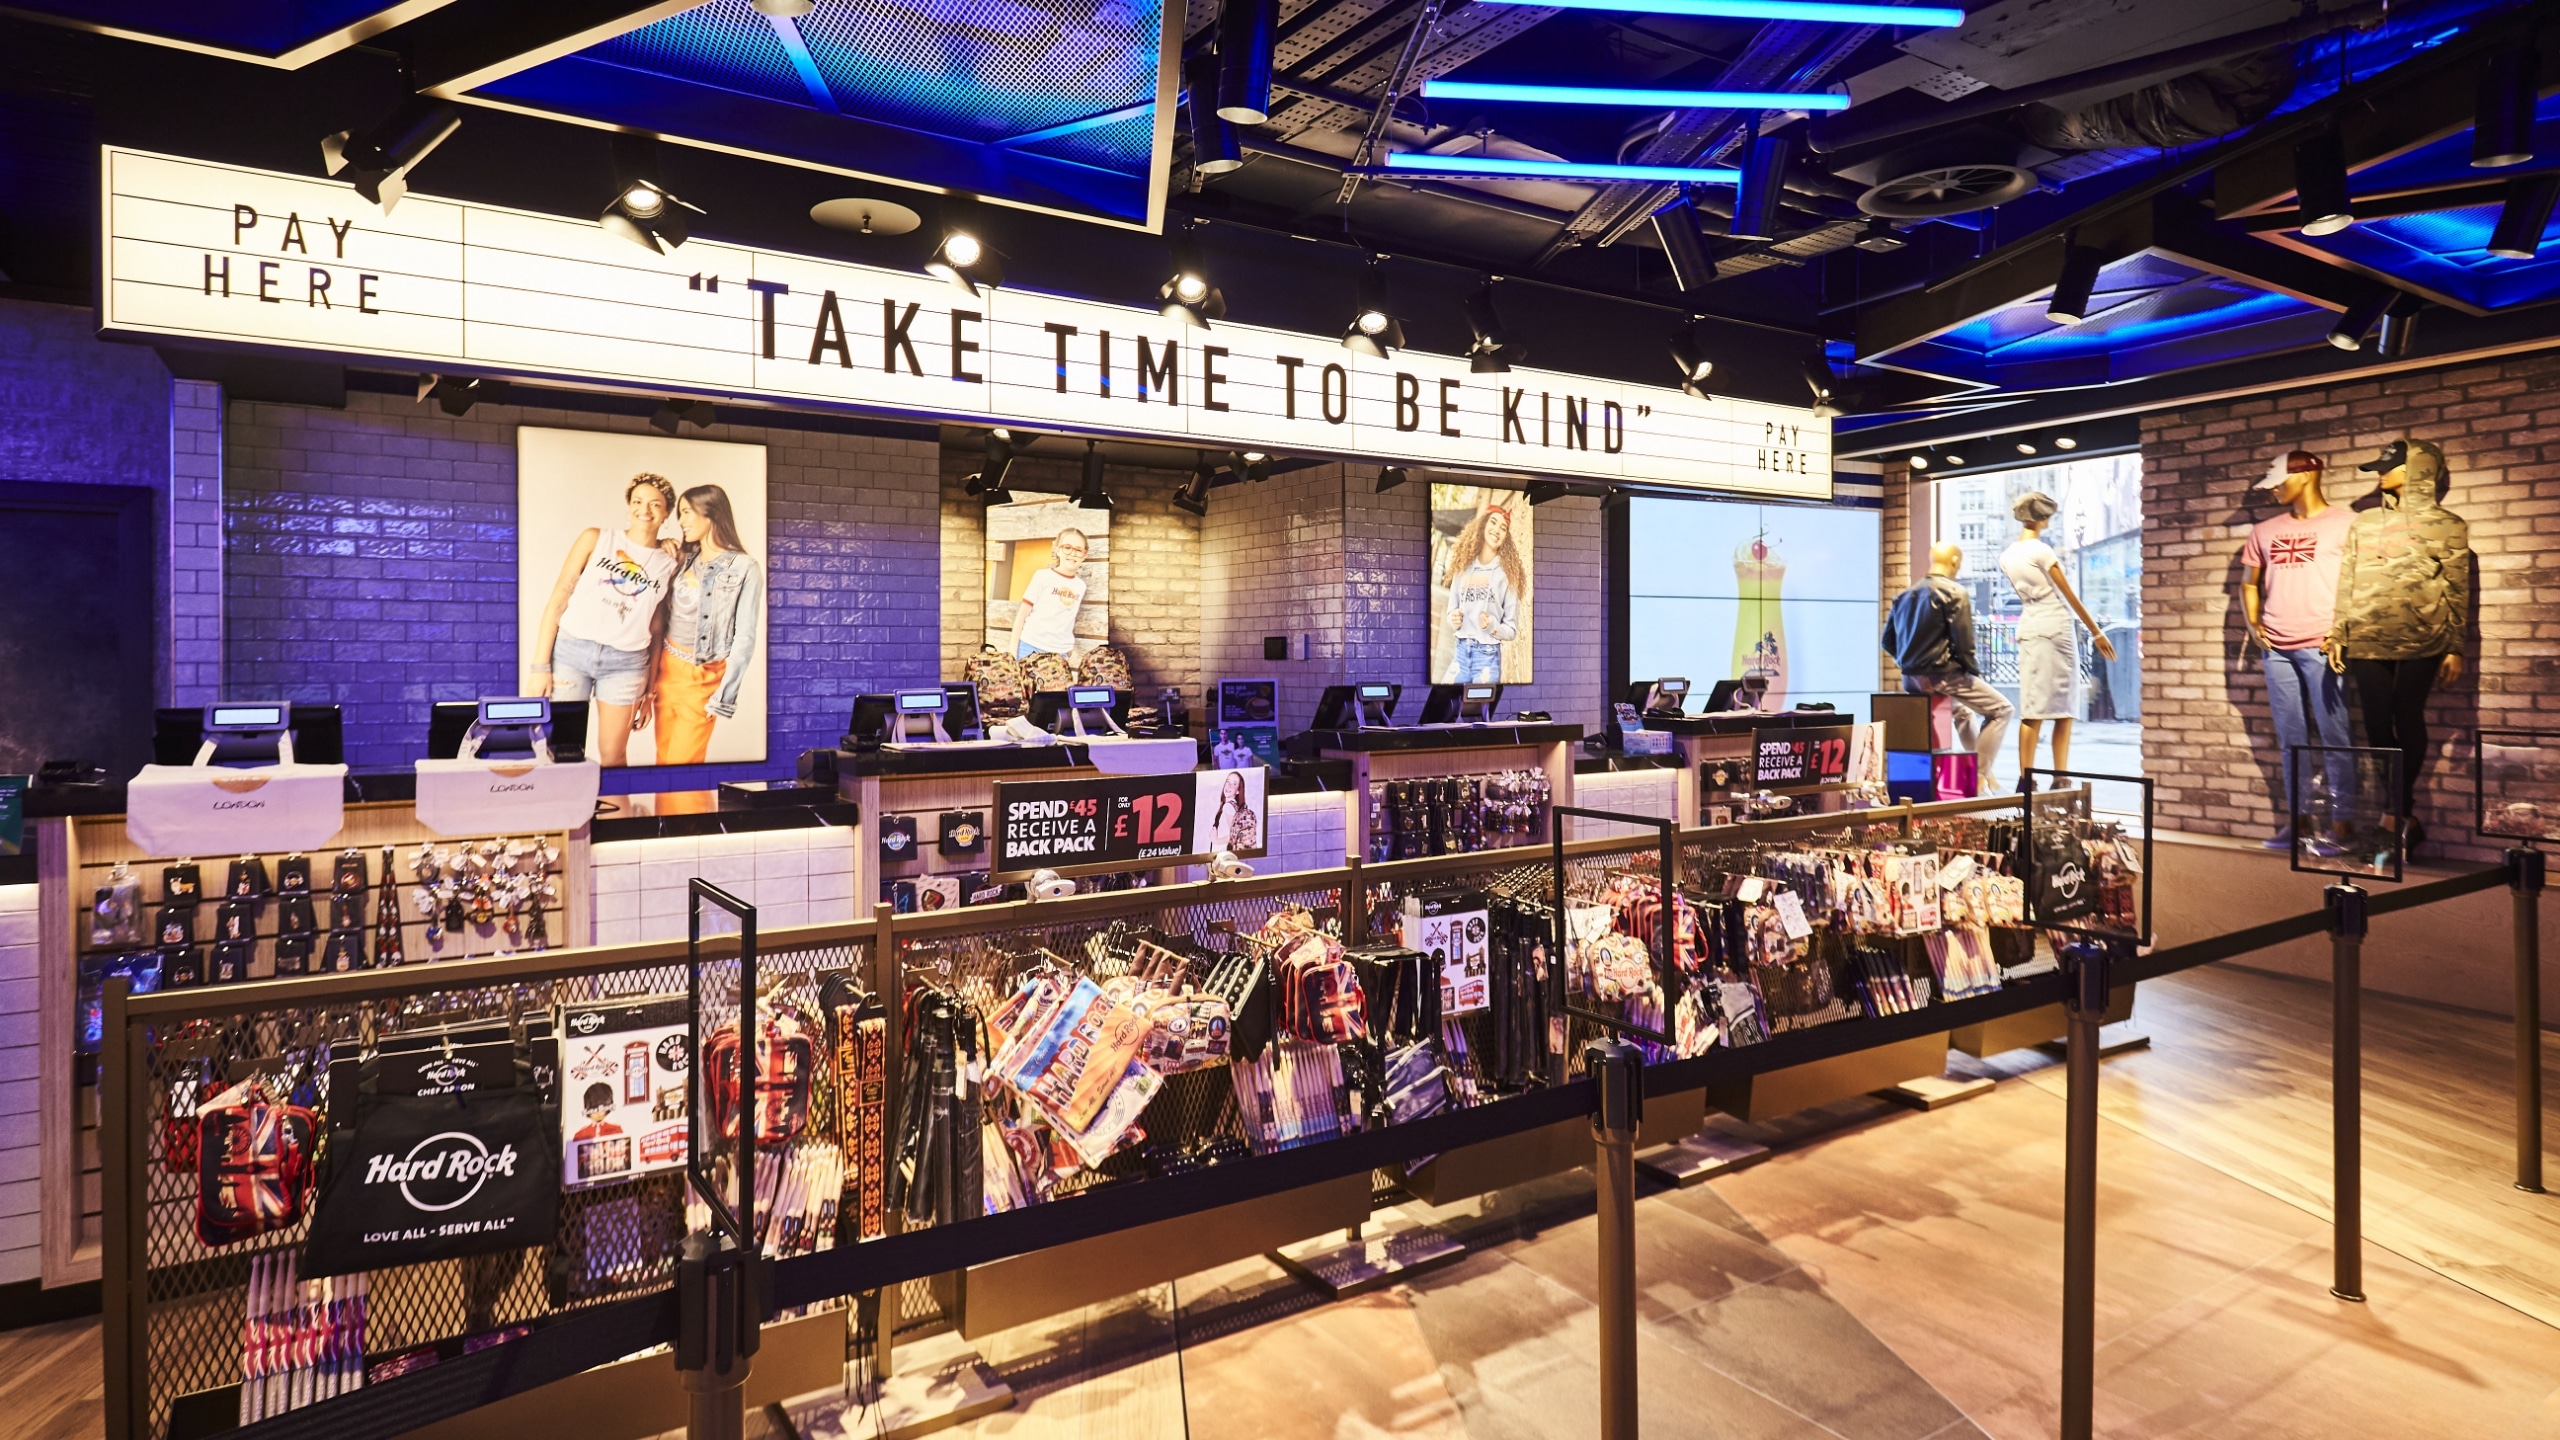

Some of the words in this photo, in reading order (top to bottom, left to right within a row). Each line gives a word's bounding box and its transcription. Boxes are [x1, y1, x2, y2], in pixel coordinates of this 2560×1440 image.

[234, 203, 352, 259] PAY
[204, 254, 379, 315] HERE
[1044, 322, 1229, 412] TIME
[1276, 355, 1347, 425] TO
[1395, 371, 1461, 437] BE
[1766, 421, 1800, 447] PAY
[1758, 448, 1806, 475] HERE
[596, 557, 631, 578] Hard
[630, 571, 661, 594] Rock
[1759, 741, 1792, 756] SPEND
[1758, 755, 1796, 768] RECEIVE
[1796, 755, 1803, 765] A
[1758, 768, 1780, 780] BACK
[1780, 767, 1802, 779] PACK
[489, 783, 534, 793] LONDON
[213, 800, 266, 810] LONDON
[1008, 800, 1069, 821] SPEND
[1069, 799, 1098, 817] £45
[948, 828, 965, 839] Hard
[1007, 819, 1080, 839] RECEIVE
[1083, 818, 1098, 834] A
[1006, 838, 1052, 858] BACK
[1053, 835, 1097, 854] PACK
[972, 891, 987, 900] HARD
[986, 888, 1001, 897] ROCK
[1613, 968, 1629, 978] Hard
[1628, 966, 1644, 978] Rock
[1036, 1037, 1092, 1112] HARD
[1077, 990, 1119, 1045] ROCK
[1110, 1030, 1128, 1053] Hard
[426, 1070, 448, 1081] Hard
[447, 1067, 467, 1079] Rock
[417, 1086, 441, 1097] CHEF
[442, 1083, 475, 1094] APRON
[364, 1151, 448, 1185] Hard
[446, 1143, 519, 1184] Rock
[363, 1229, 400, 1243] LOVE
[402, 1227, 427, 1241] ALL
[438, 1221, 481, 1237] SERVE
